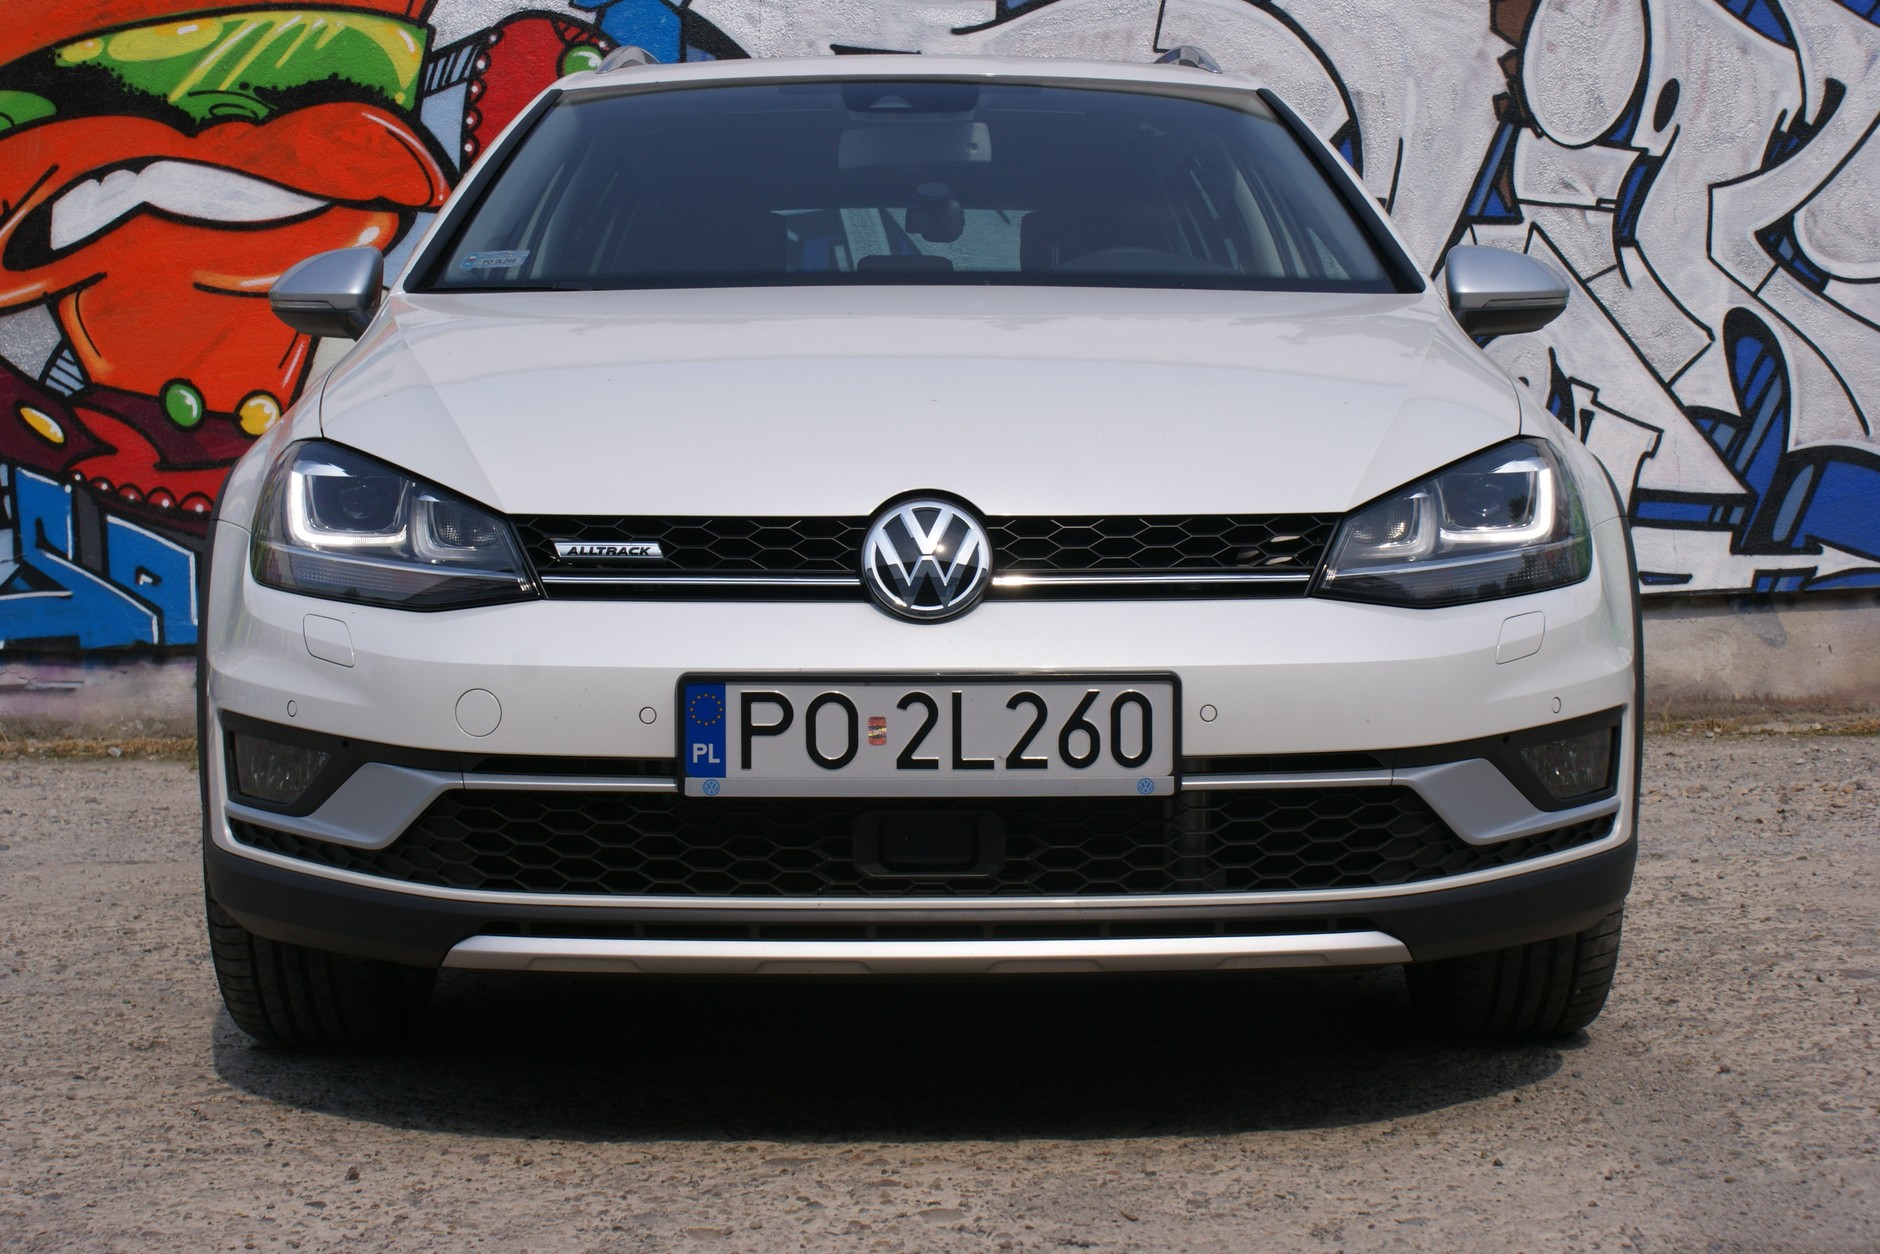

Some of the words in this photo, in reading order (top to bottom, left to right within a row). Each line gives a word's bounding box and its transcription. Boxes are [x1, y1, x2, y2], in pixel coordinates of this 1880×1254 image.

[566, 546, 651, 556] ALLTRACK
[866, 500, 988, 612] VW
[692, 743, 720, 764] PL
[740, 690, 859, 770] PO
[896, 689, 1153, 770] 2L260
